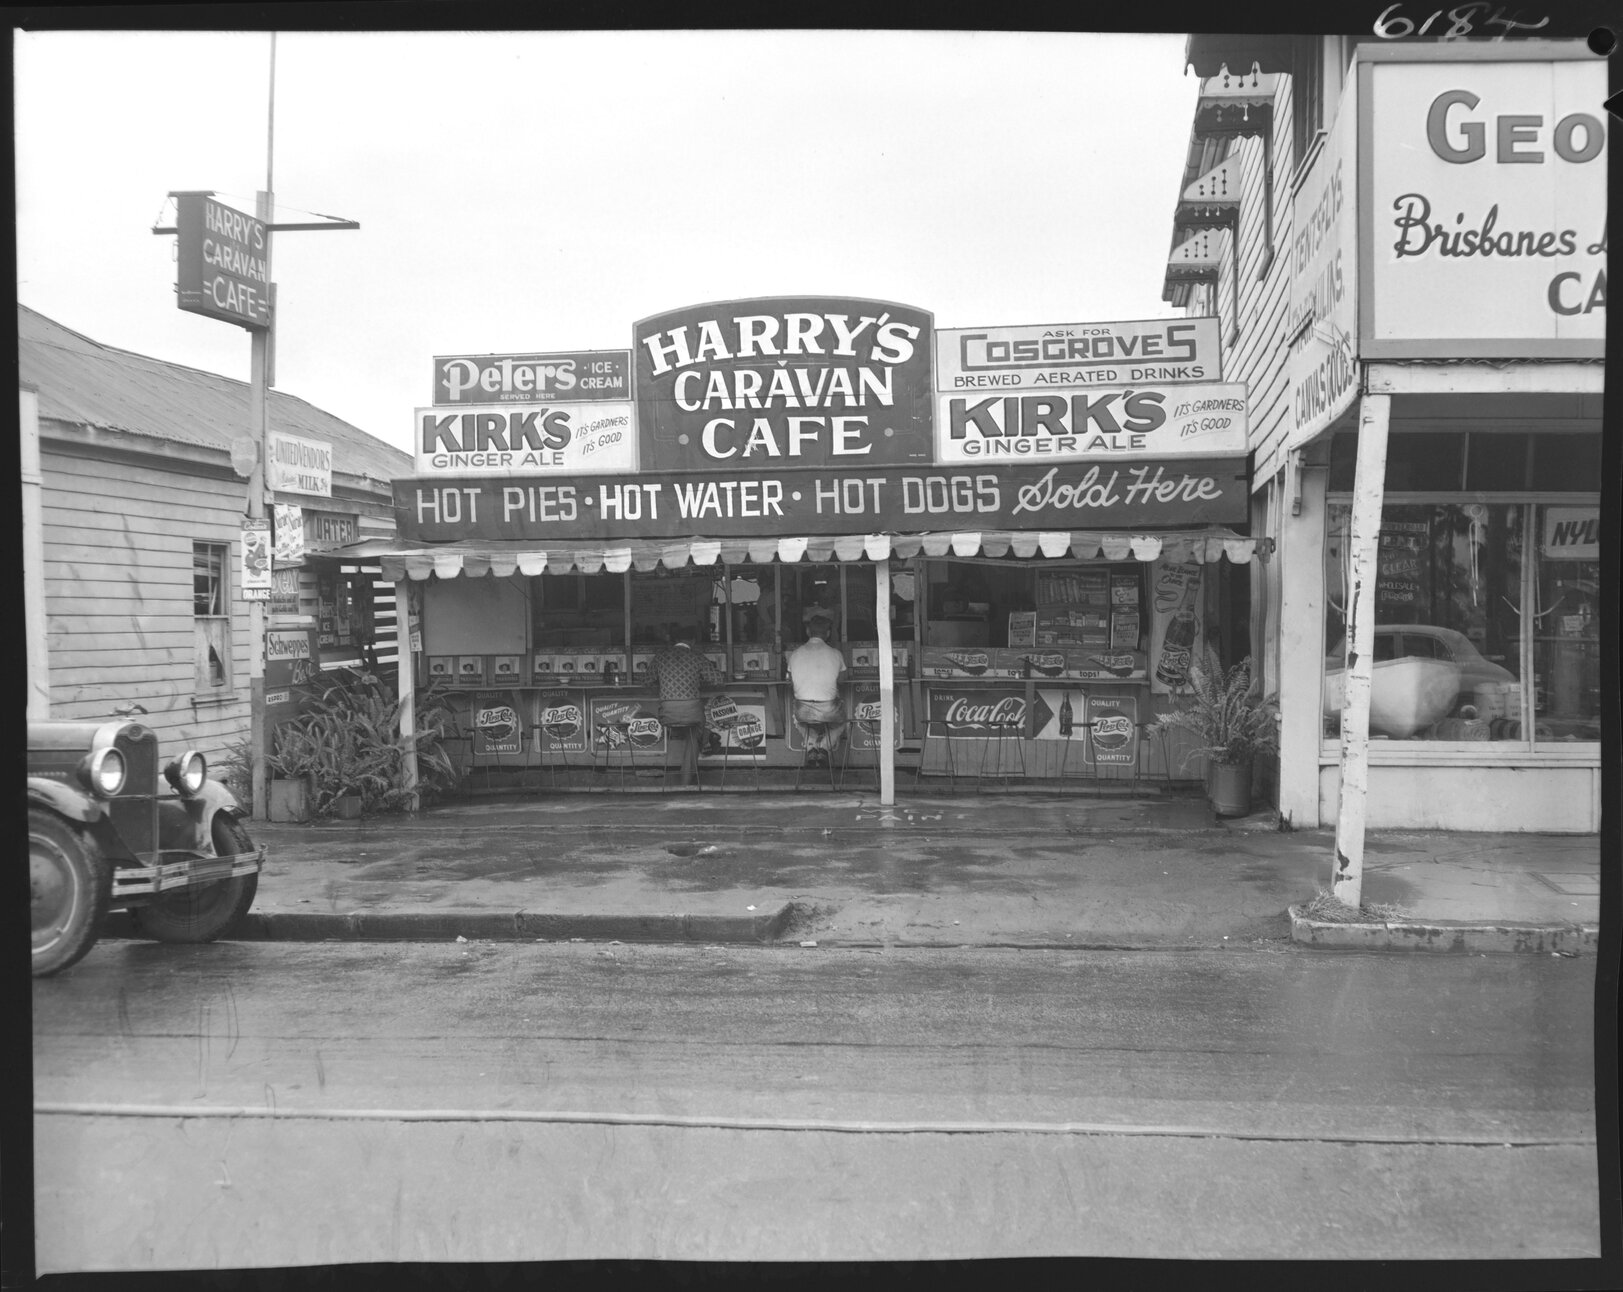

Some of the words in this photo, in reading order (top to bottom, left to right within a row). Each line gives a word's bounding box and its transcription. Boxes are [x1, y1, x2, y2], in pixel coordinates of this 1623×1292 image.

[1426, 89, 1605, 164] GEO
[206, 201, 264, 250] HARRY'S
[1393, 193, 1577, 258] Brisbanes
[203, 239, 266, 283] CARAVAN
[213, 276, 257, 319] CAFE
[642, 312, 920, 376] HARRY'S
[1042, 330, 1074, 338] ASK
[1083, 328, 1111, 337] FOR
[960, 325, 1196, 371] COSGROVES
[591, 362, 612, 373] ICE
[954, 374, 1022, 388] BREWED
[1034, 370, 1117, 384] AERATED
[1131, 366, 1205, 380] DRINKS
[580, 376, 623, 389] CREAM
[674, 367, 894, 412] CARAVAN
[949, 390, 1167, 440] KIRK'S
[1174, 402, 1190, 418] IT'S
[1192, 399, 1245, 413] GARDNERS
[422, 408, 571, 454] KIRK'S
[575, 424, 589, 439] IT'S
[590, 416, 629, 432] GARDNERS
[701, 416, 873, 459] CAFE
[1180, 421, 1198, 437] IT'S
[1200, 417, 1231, 431] GOOD
[582, 441, 595, 455] IT'S
[598, 432, 622, 447] GOOD
[962, 437, 1077, 455] GINGER
[1087, 434, 1147, 450] ALE
[432, 453, 513, 468] GINGER
[521, 452, 565, 466] ALE
[298, 474, 319, 492] MILK
[416, 487, 482, 524] HOT
[503, 486, 577, 522] PIES
[599, 483, 661, 520] HOT
[673, 480, 784, 519] WATER
[815, 477, 887, 514] HOT
[902, 474, 1000, 514] DOGS
[1011, 466, 1120, 516] Sold
[1125, 465, 1223, 506] Here
[1551, 519, 1600, 547] NYL
[243, 589, 270, 600] ORANGE
[268, 633, 309, 659] Schweppes
[1080, 671, 1100, 679] tops!
[1091, 699, 1120, 707] QUALITY
